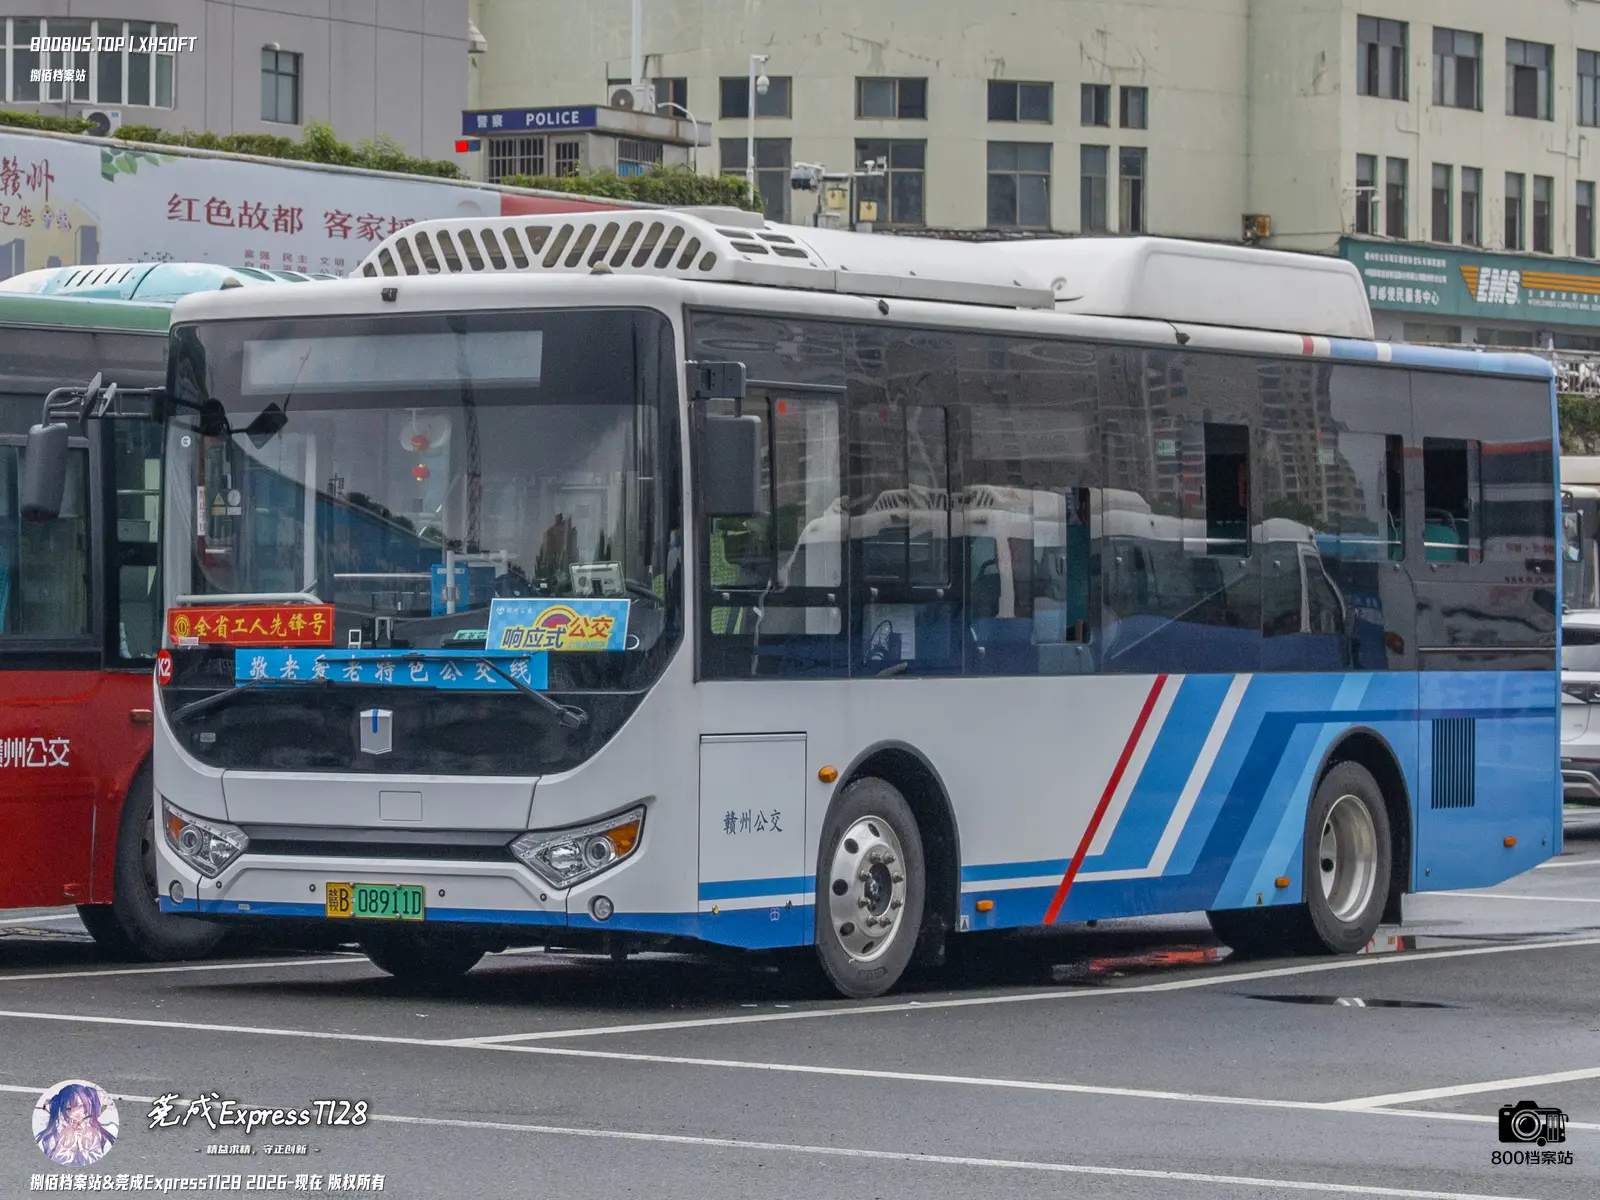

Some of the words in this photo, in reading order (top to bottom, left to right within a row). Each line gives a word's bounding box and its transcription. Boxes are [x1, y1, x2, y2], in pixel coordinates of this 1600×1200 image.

[526, 111, 579, 126] POLICE
[167, 193, 304, 235] 红色故都
[1476, 266, 1520, 305] EMS
[194, 612, 326, 638] 全省工人先锋号
[502, 626, 566, 648] 响应式
[568, 617, 613, 639] 公交
[158, 658, 171, 677] K2
[249, 655, 532, 685] 敬老爱老特色公交线
[0, 737, 70, 768] 州公交
[723, 809, 783, 835] 赣州公交
